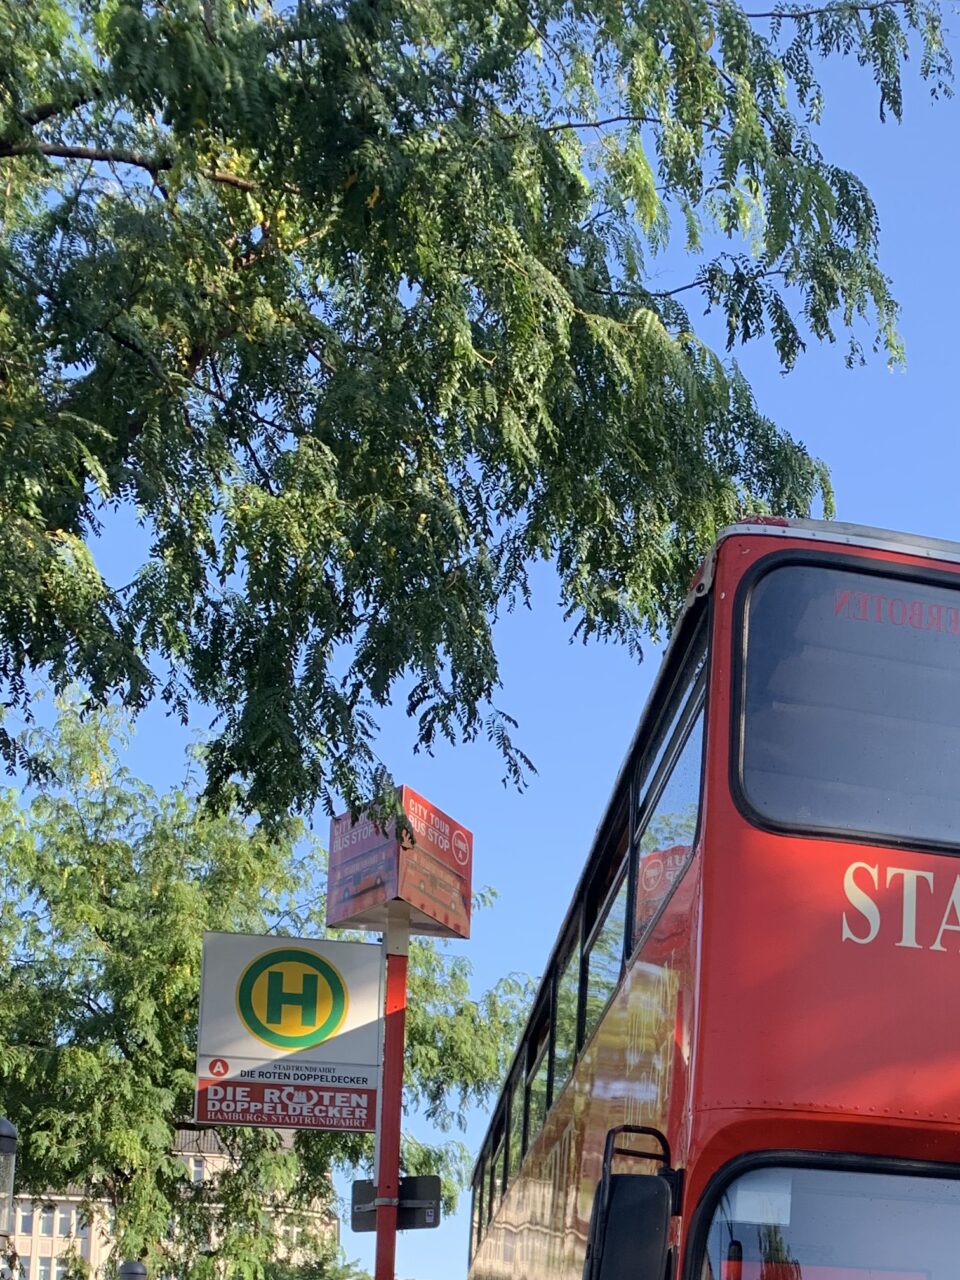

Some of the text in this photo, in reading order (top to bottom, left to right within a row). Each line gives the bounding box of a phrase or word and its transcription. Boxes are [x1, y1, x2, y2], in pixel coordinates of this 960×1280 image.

[410, 798, 450, 836] CITY TOUR
[333, 823, 374, 853] BUS STOP
[428, 828, 450, 852] STOP
[266, 971, 318, 1027] H
[213, 1061, 336, 1074] A STADTRUNDFAHRT
[240, 1070, 368, 1085] DIE ROTEN DOPPELDECKER
[207, 1086, 250, 1101] DIE
[207, 1100, 368, 1119] DOPPELDECKER
[207, 1111, 367, 1127] HAMBURGS STADTRUNDFAHRT
